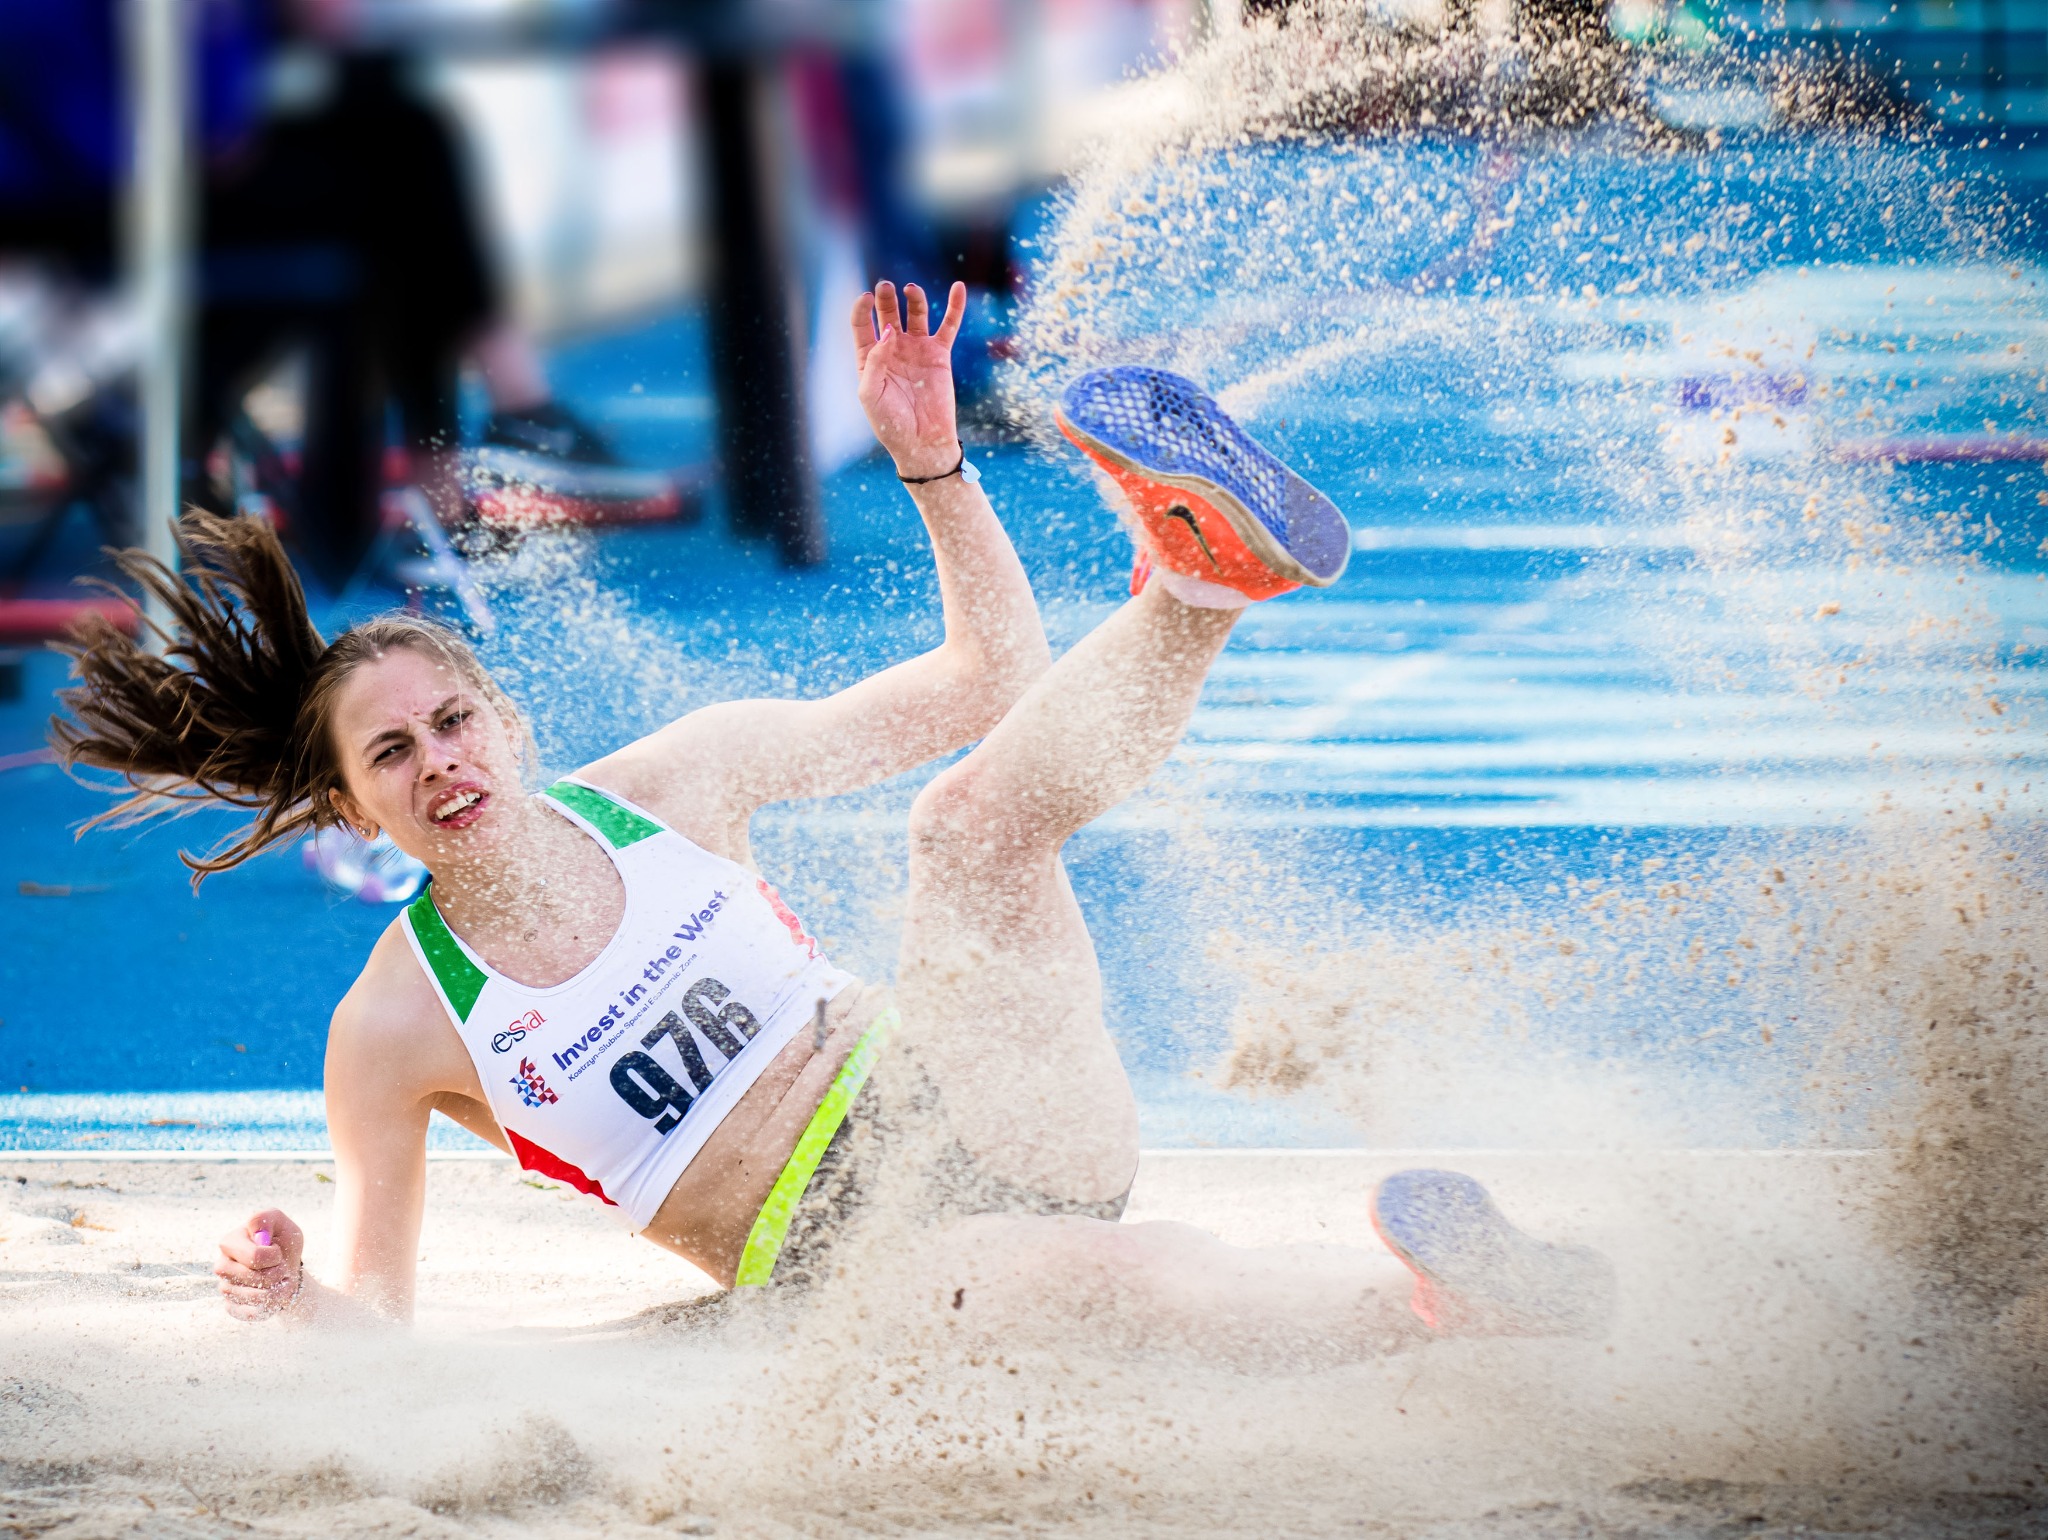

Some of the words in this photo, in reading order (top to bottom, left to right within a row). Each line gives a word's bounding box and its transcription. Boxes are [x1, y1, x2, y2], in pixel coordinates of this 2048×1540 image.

[552, 1003, 626, 1072] Invest
[619, 983, 648, 1007] in
[643, 945, 682, 983] the
[673, 889, 728, 942] West
[609, 977, 762, 1136] 976
[623, 1003, 650, 1030] Special
[678, 953, 698, 972] Zone
